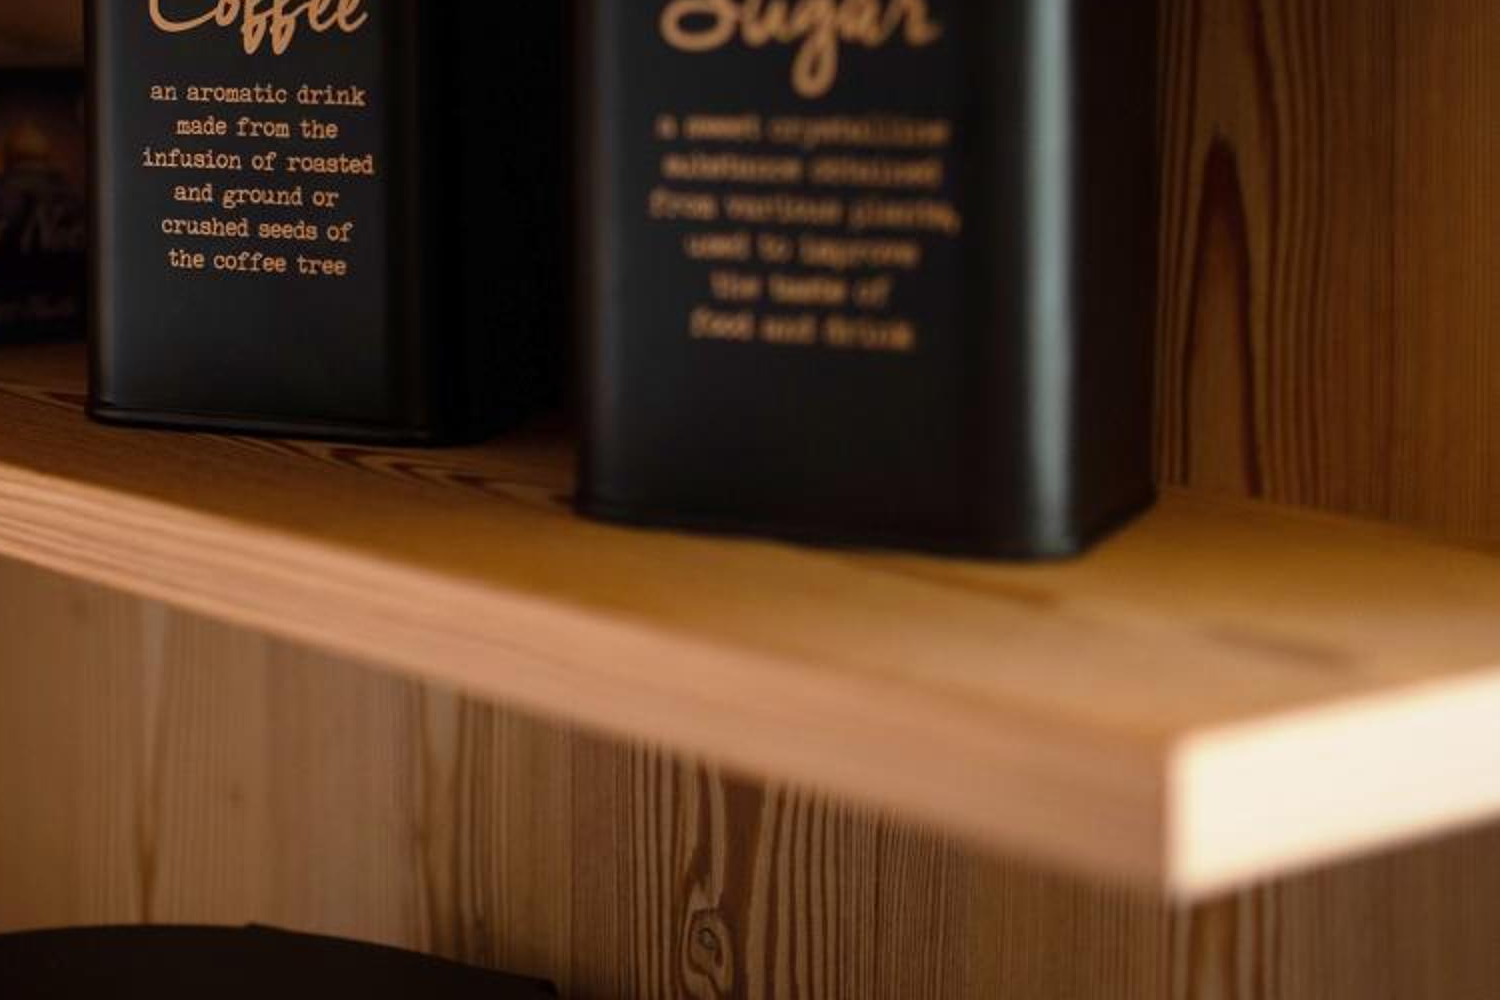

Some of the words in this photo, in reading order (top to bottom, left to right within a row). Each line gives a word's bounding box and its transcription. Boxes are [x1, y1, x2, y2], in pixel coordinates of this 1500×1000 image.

[150, 85, 177, 102] an
[186, 84, 288, 105] aromatic
[297, 84, 367, 108] drink
[176, 116, 228, 138] made
[236, 117, 291, 139] from
[301, 120, 340, 141] the
[143, 147, 242, 170] infusion
[251, 151, 277, 171] of
[286, 154, 373, 176] roasted
[173, 183, 214, 203] and
[222, 185, 303, 210] ground
[312, 189, 340, 209] or
[161, 217, 250, 239] crushed
[258, 220, 318, 241] seeds
[326, 223, 354, 243] of
[168, 249, 206, 270] the
[213, 252, 287, 273] coffee
[297, 257, 349, 277] tree
